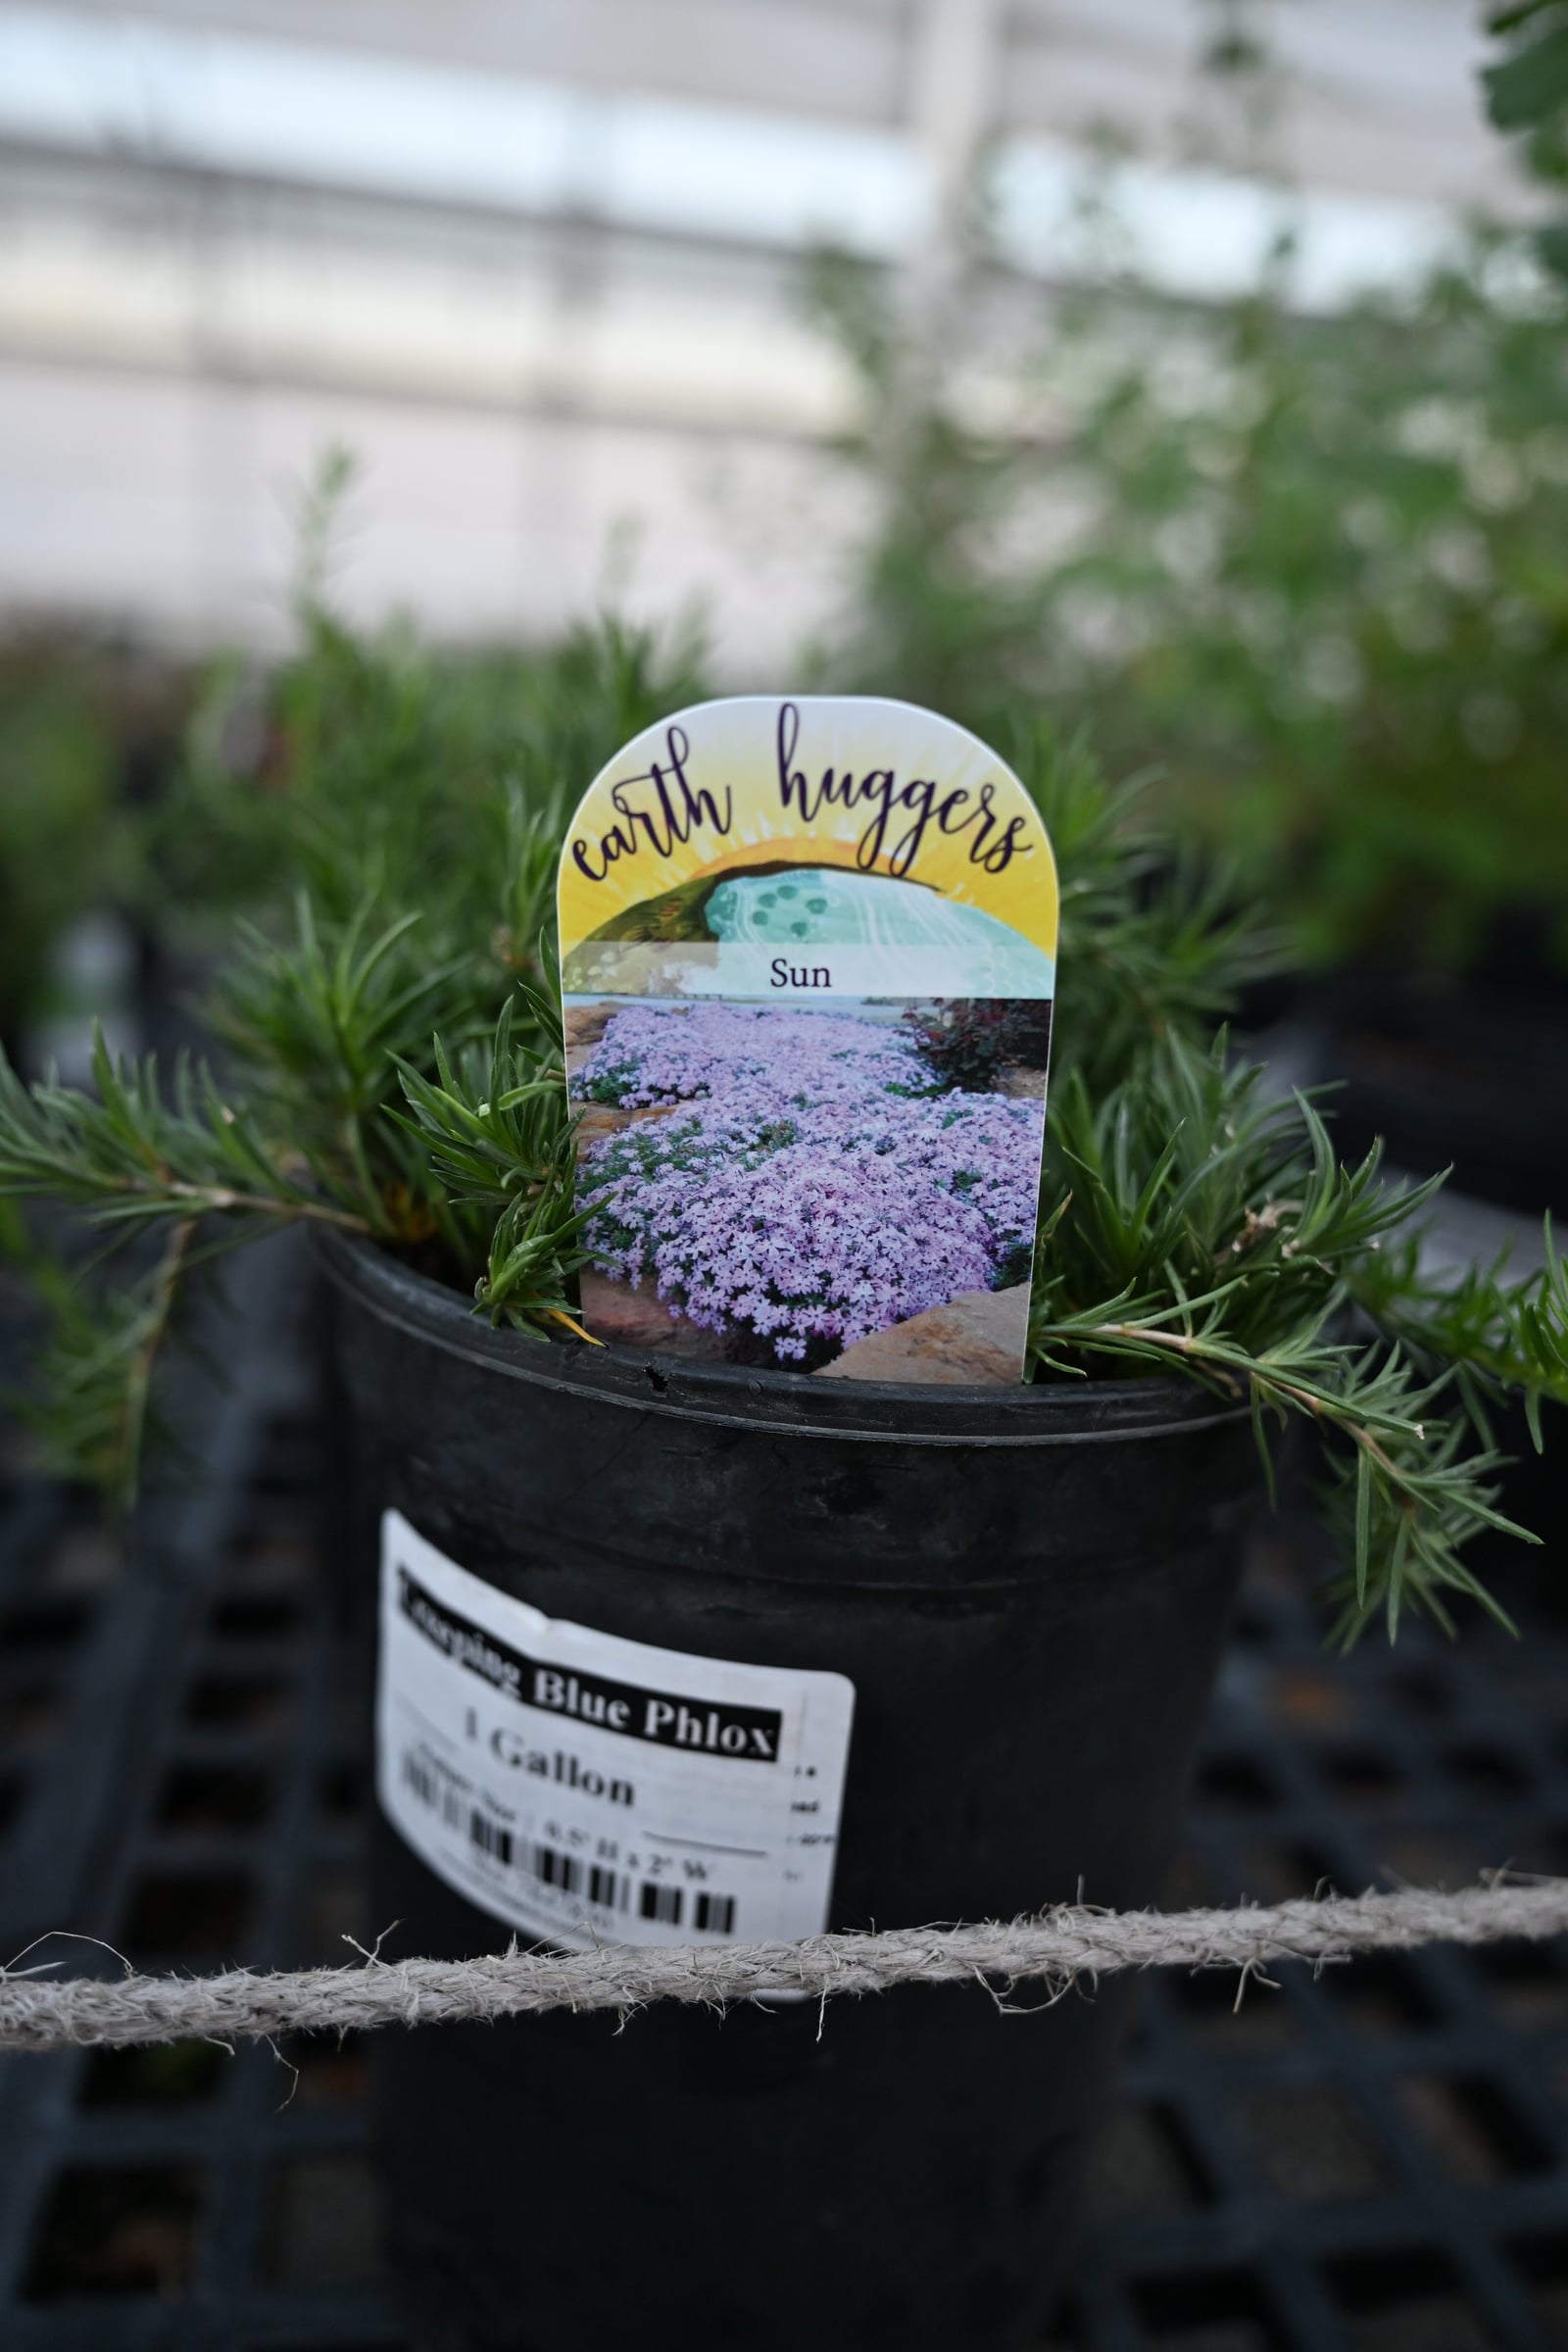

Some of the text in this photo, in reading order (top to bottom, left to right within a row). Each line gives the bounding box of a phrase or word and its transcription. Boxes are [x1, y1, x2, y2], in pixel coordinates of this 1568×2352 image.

[572, 703, 1034, 881] earth huggers
[769, 957, 832, 988] Sun
[533, 1669, 630, 1729] Blue
[642, 1698, 774, 1756] Phlox
[490, 1728, 635, 1807] Gallon
